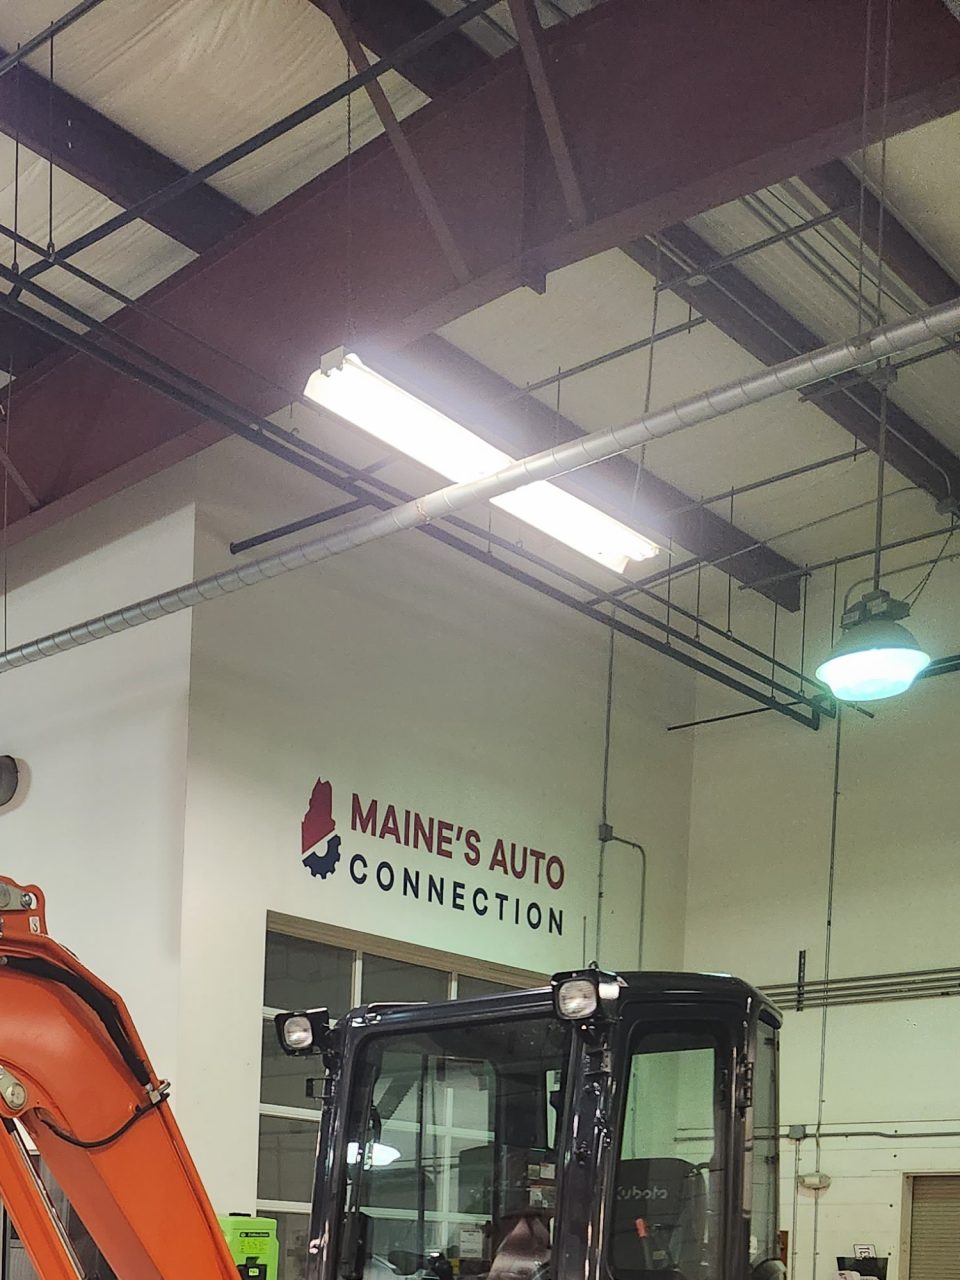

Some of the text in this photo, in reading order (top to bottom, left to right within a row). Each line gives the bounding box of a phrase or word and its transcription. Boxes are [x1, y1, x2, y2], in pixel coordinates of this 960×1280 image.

[350, 792, 565, 890] MAINE'S AUTO
[349, 853, 563, 936] CONNECTION
